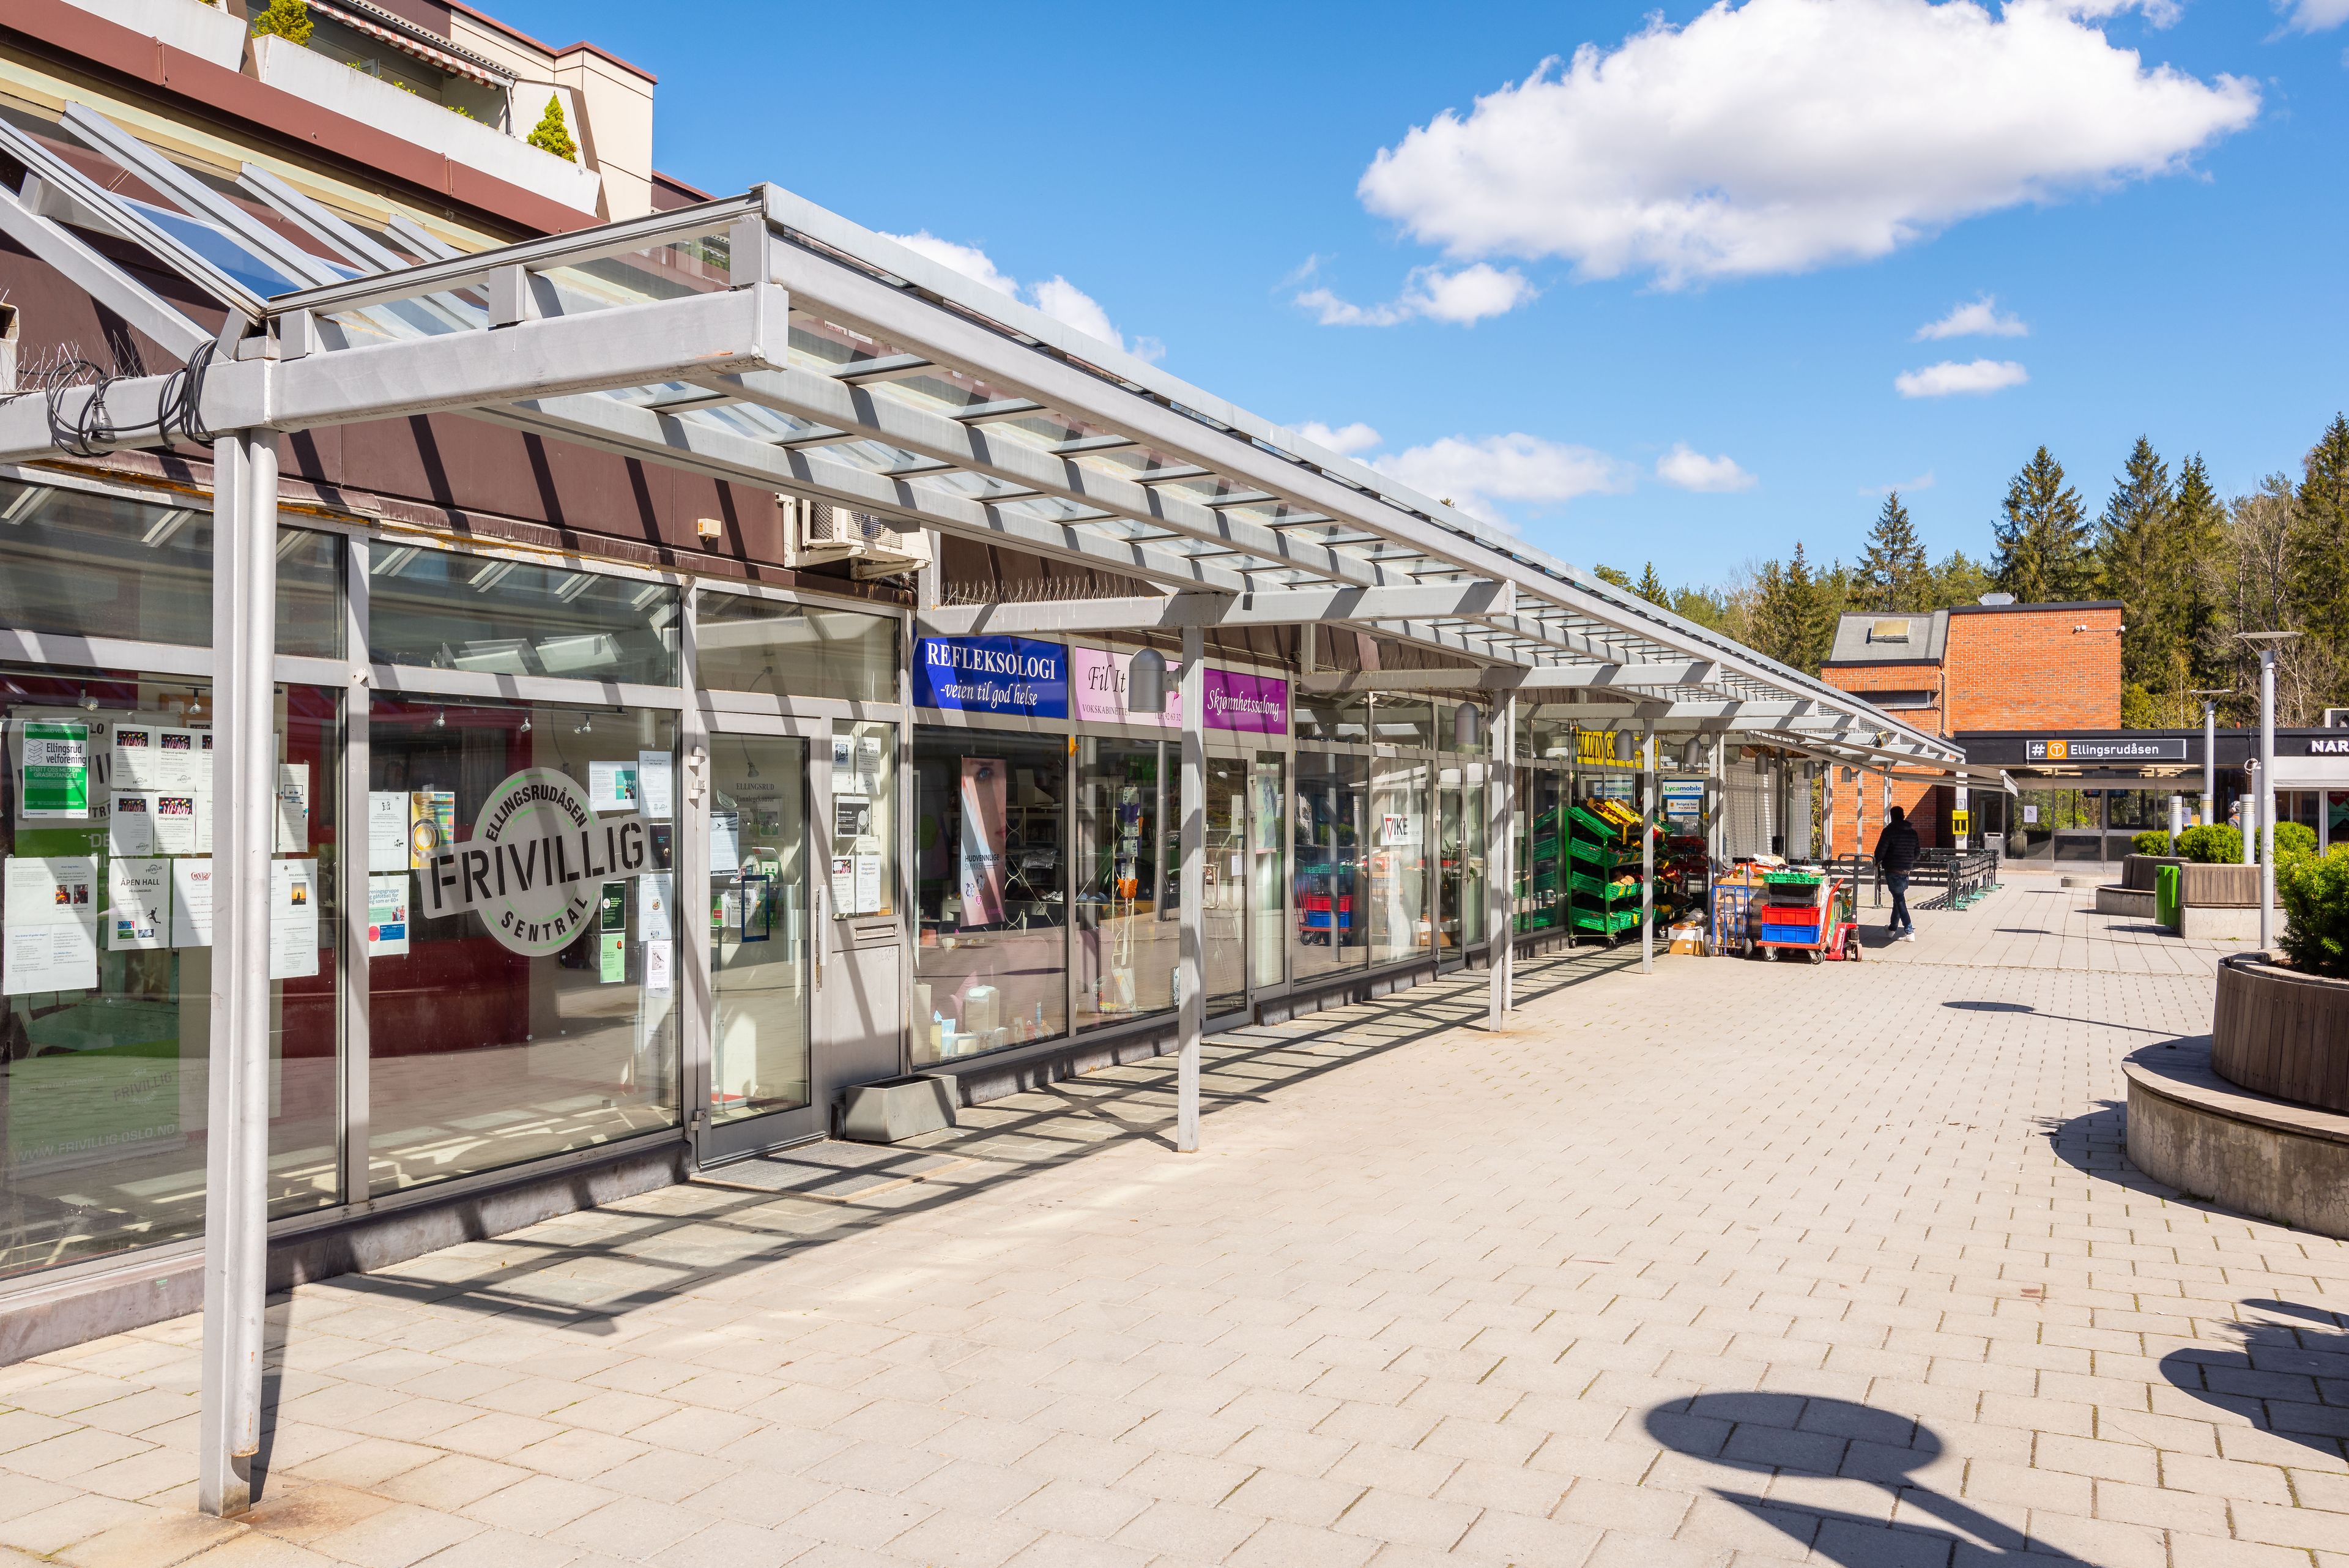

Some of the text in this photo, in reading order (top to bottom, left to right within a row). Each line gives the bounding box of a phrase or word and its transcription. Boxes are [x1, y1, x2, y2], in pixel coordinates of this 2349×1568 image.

[927, 642, 1056, 680] REFLEKSOLOGI
[1088, 664, 1126, 693] Fil It
[940, 680, 1037, 709] -veien til god helse
[1207, 688, 1280, 723] Skjønnhetssalong
[90, 723, 105, 734] LO
[46, 743, 82, 756] Ellingsrud
[46, 755, 87, 766] velforening
[1576, 732, 1615, 760] ELLINGS
[2071, 743, 2159, 757] Ellingsrudåsen
[2312, 740, 2349, 752] NAR
[486, 784, 588, 842] ELLINGSRUDÅSEN
[430, 822, 644, 910] FRIVILLIG
[121, 877, 140, 886] ÅPEN
[501, 897, 588, 942] SENTRAL
[114, 1072, 173, 1101] FRIVILLIG
[14, 1124, 176, 1161] WWW.FRIVILLIG-OSLO.NO
